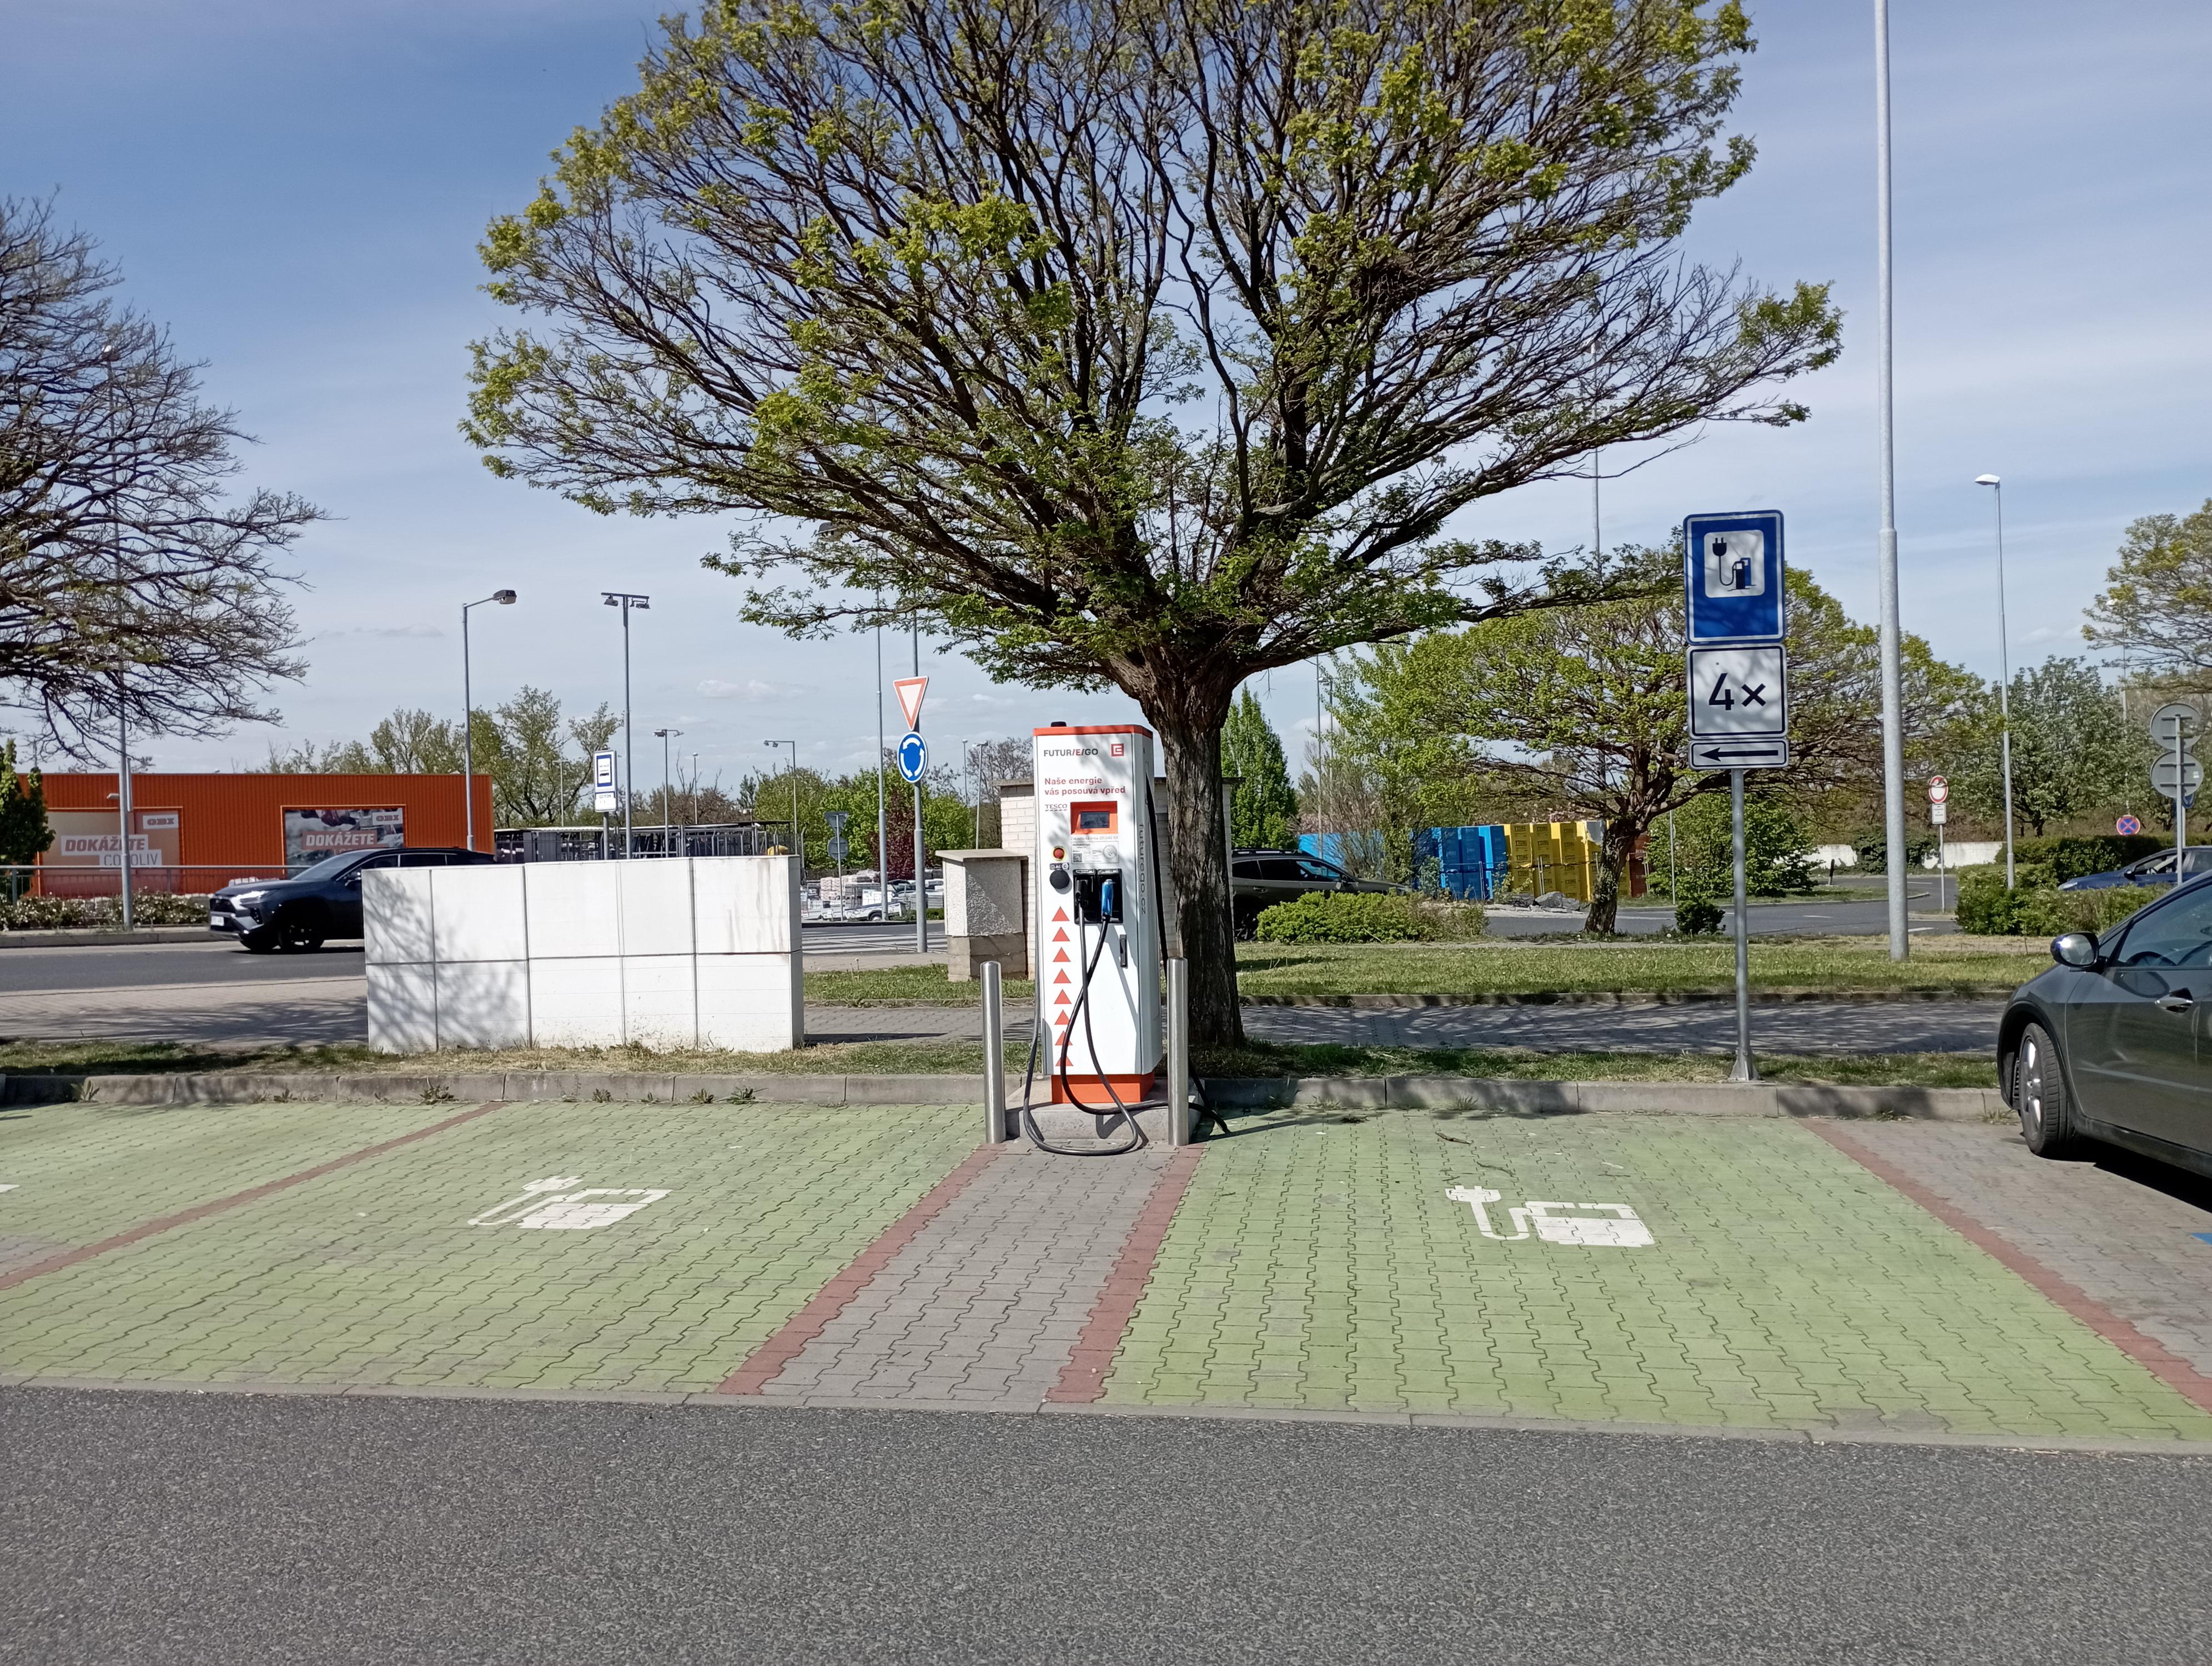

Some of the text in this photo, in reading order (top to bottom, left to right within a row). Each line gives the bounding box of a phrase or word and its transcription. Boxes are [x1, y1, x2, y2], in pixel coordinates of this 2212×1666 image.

[1043, 748, 1098, 757] FUTUR/E/GO
[1069, 776, 1102, 785] energie
[1062, 786, 1098, 796] posouvá
[1100, 786, 1126, 795] vpřed
[65, 836, 145, 852] DOKÁŽTE
[305, 831, 375, 846] DOKÁŽETE
[104, 853, 158, 866] COOLIV
